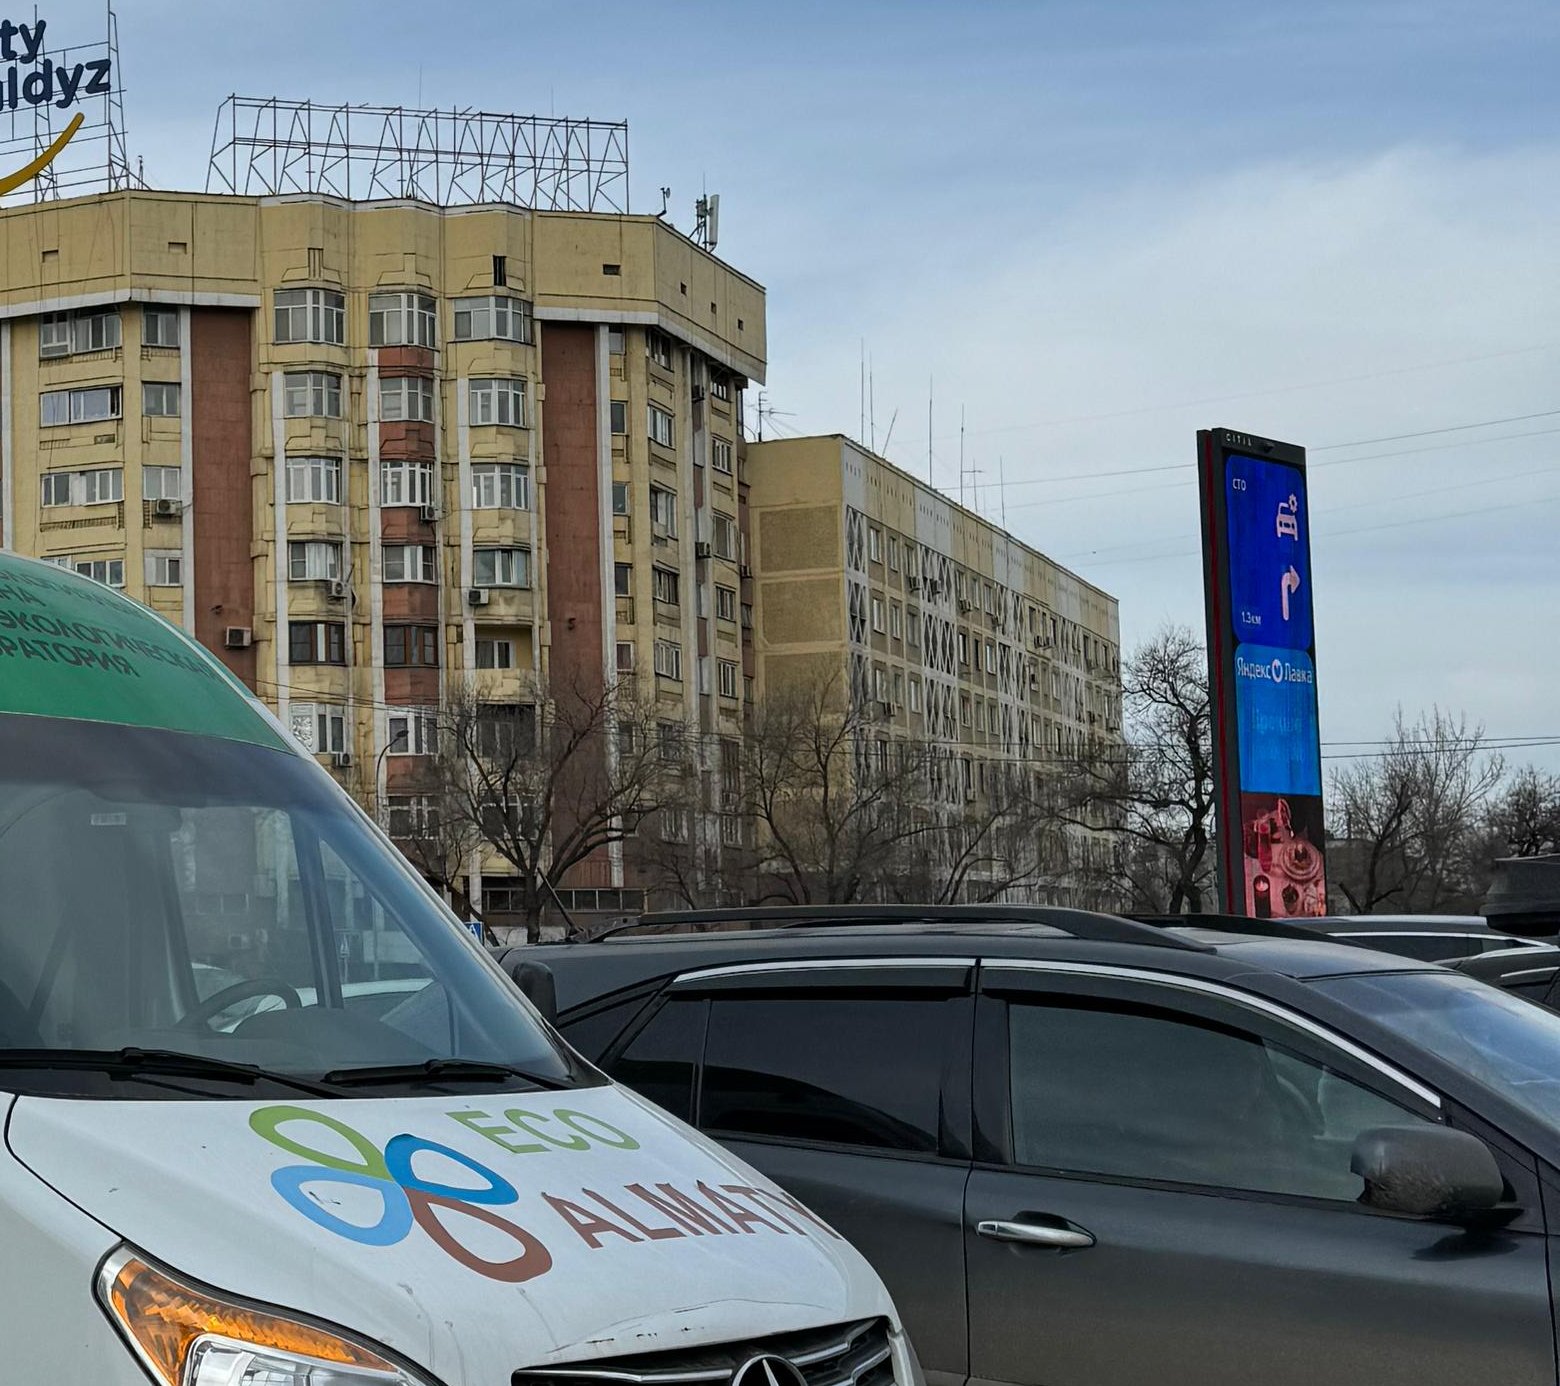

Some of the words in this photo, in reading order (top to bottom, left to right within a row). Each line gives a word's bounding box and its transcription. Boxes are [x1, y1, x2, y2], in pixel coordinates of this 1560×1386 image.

[1237, 657, 1271, 680] Яндекс
[1284, 663, 1313, 684] Лавка
[445, 1107, 641, 1155] ECO
